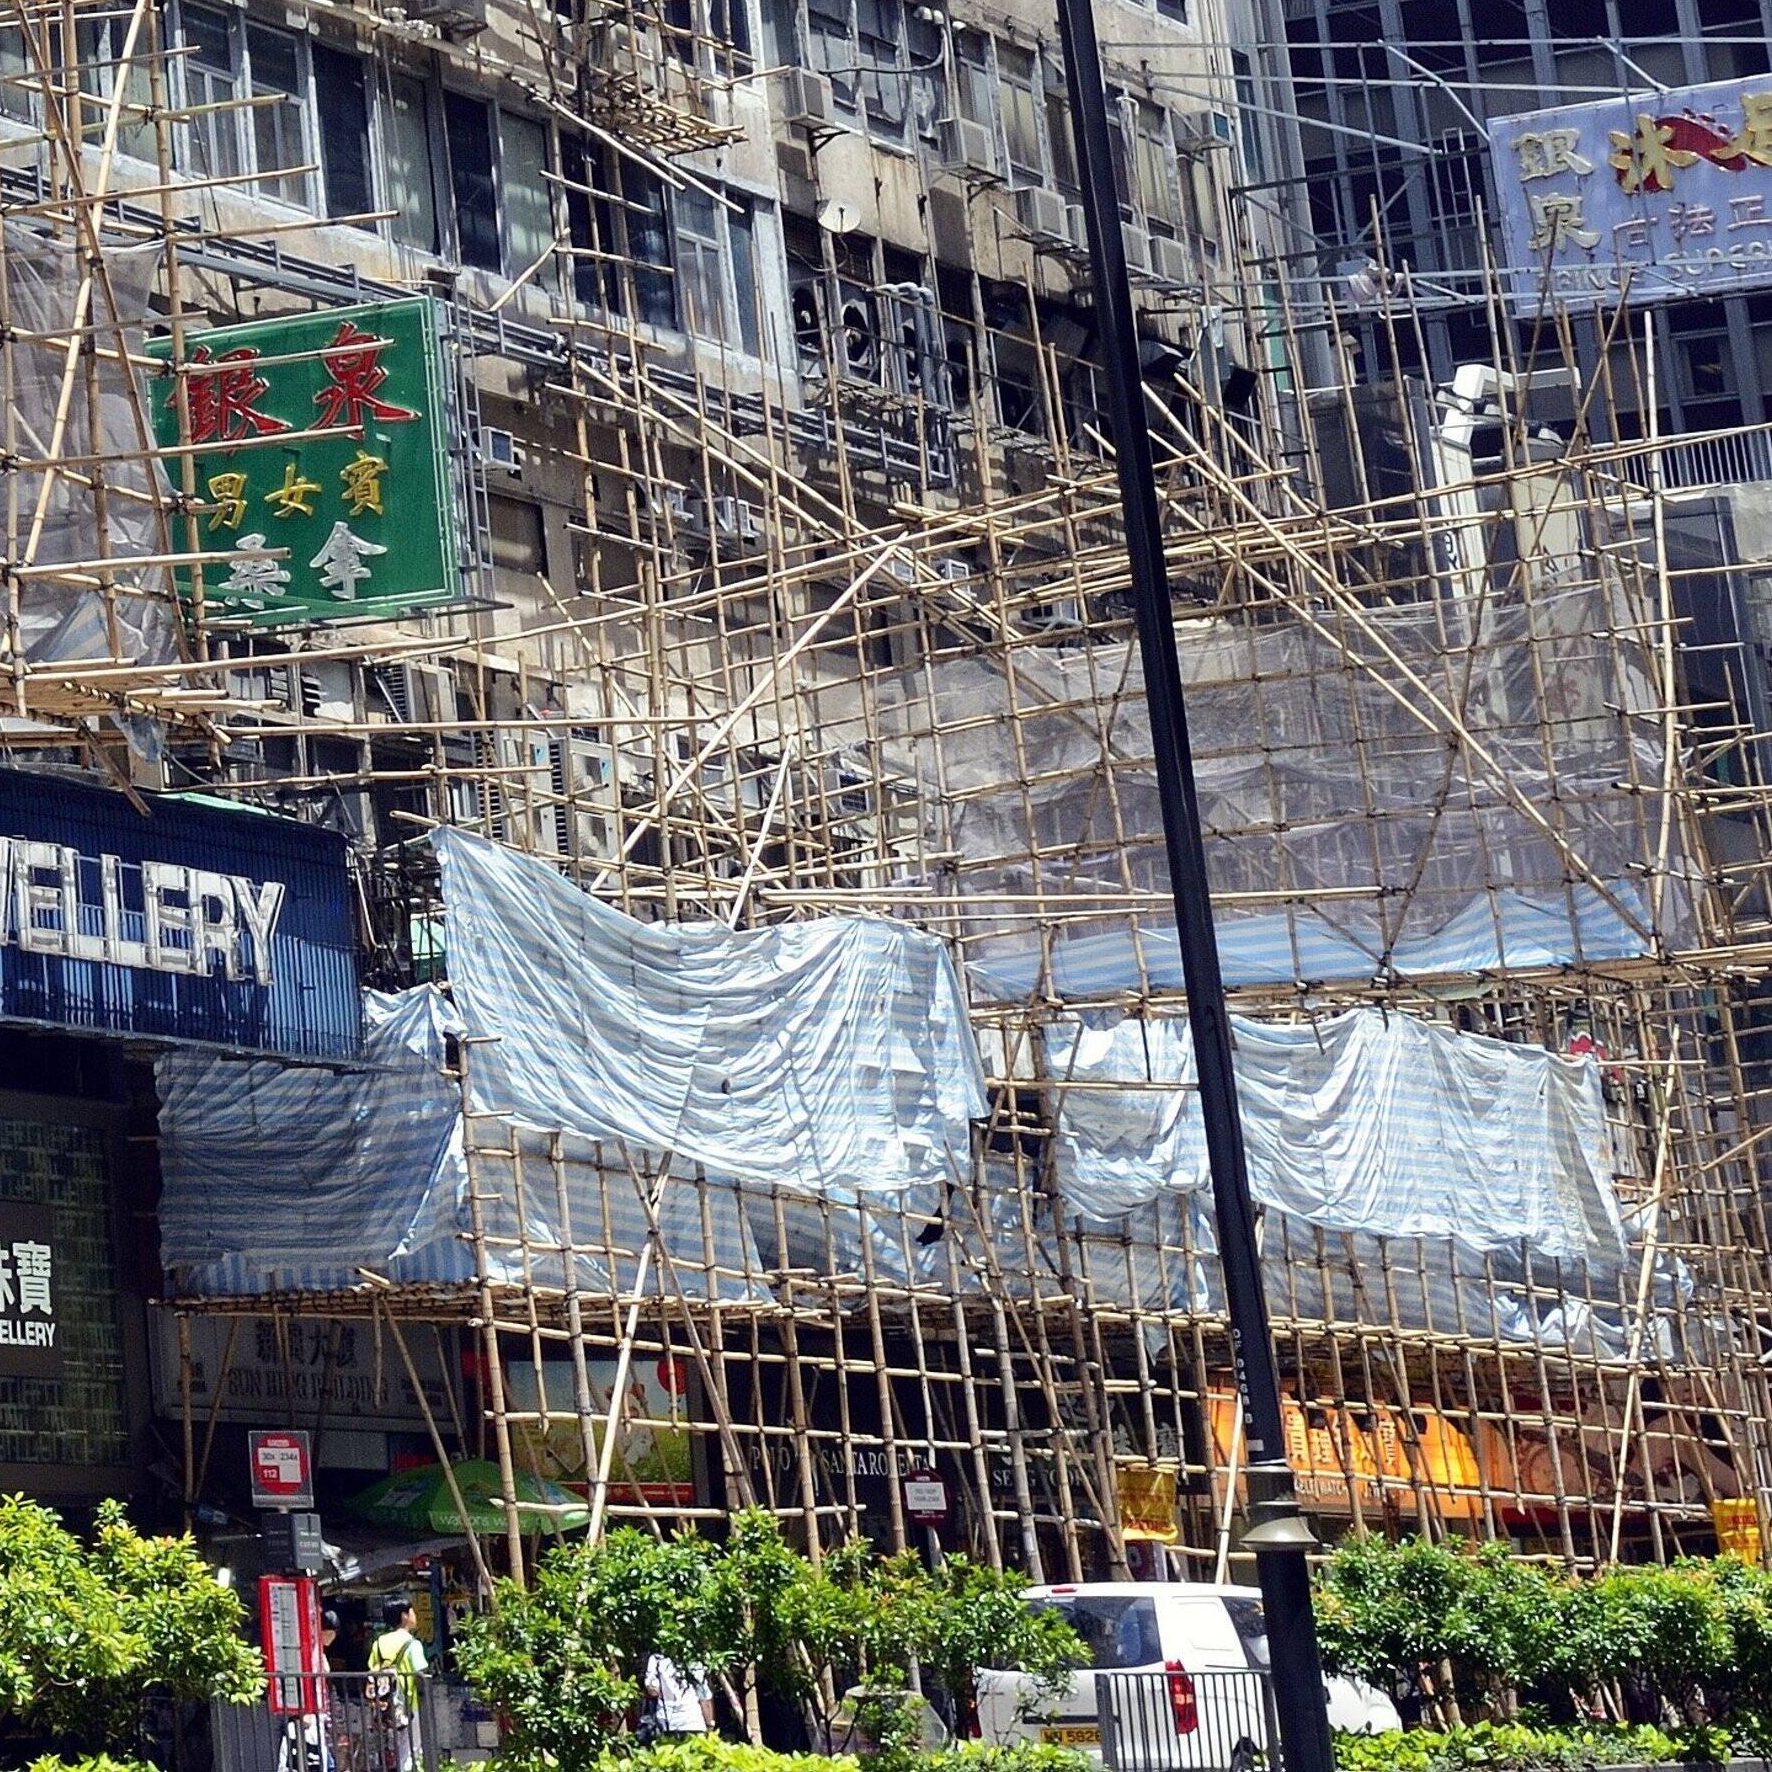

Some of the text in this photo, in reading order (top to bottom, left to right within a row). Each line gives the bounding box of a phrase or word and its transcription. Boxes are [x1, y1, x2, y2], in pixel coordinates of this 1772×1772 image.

[165, 320, 423, 455] 銀泉
[208, 450, 389, 531] 男女賓
